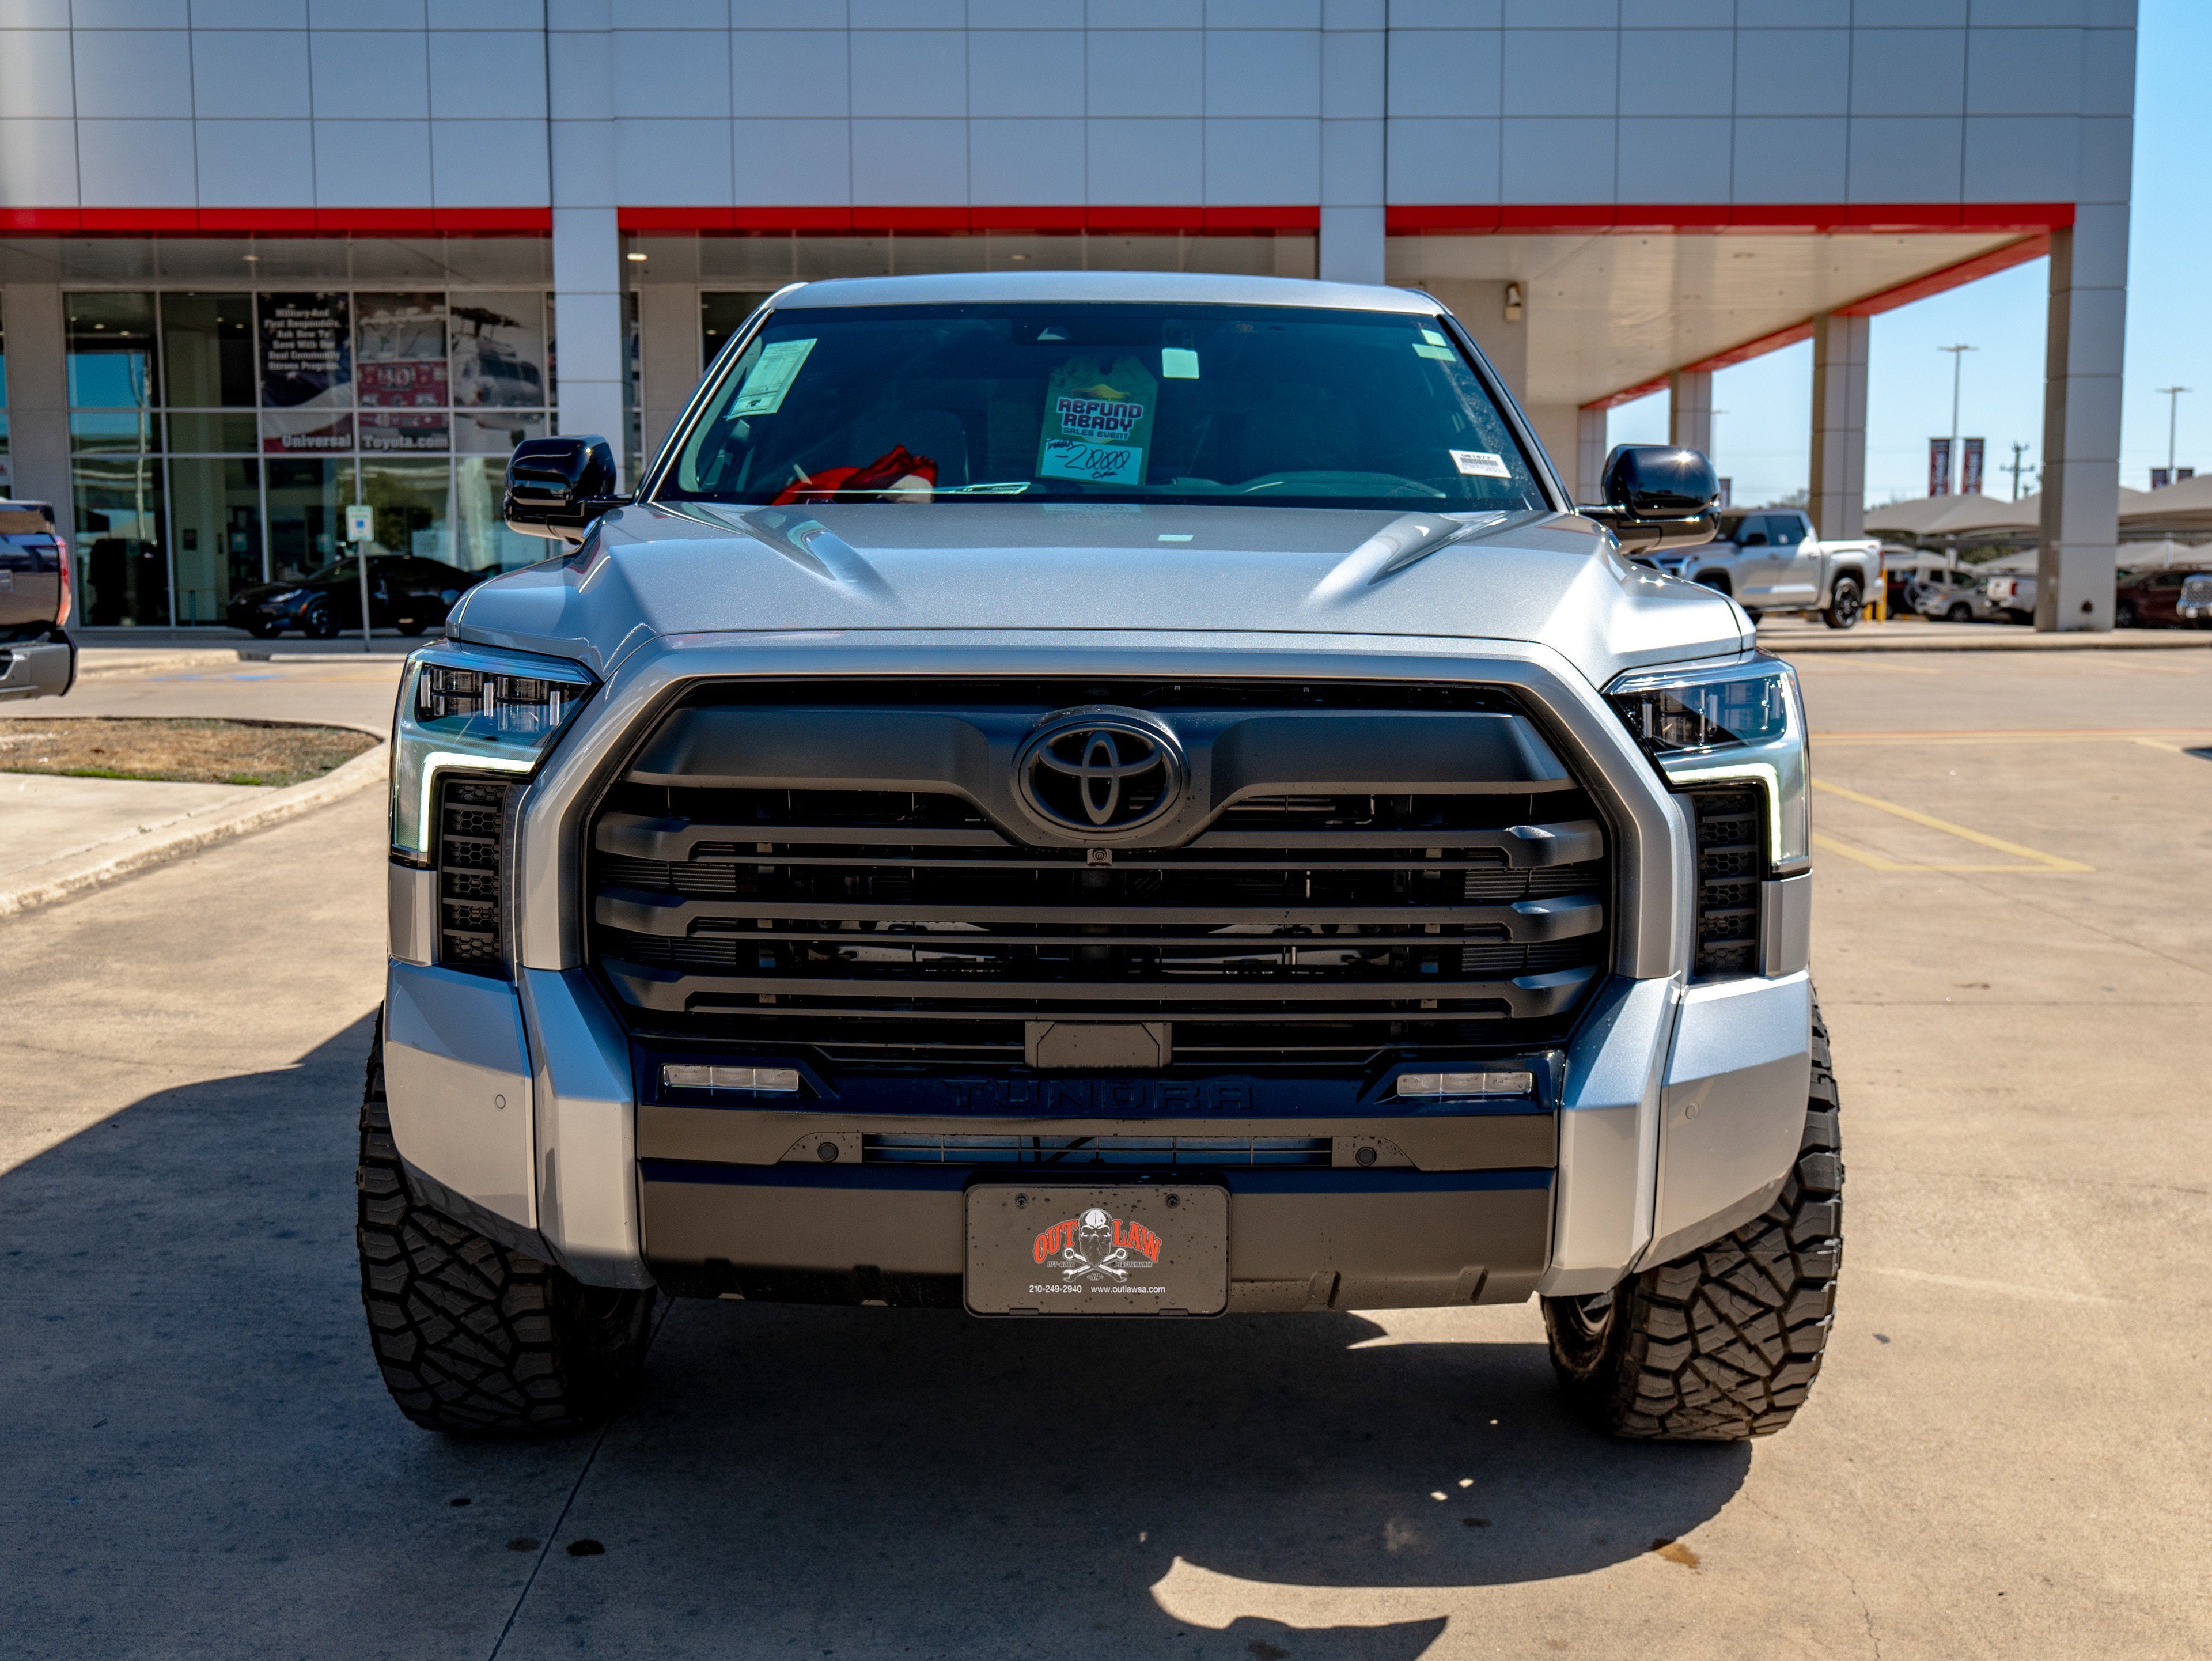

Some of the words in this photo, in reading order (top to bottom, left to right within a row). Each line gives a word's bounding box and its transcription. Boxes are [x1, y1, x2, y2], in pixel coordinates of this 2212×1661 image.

[1058, 398, 1142, 418] REFUND
[1063, 413, 1132, 432] READY
[282, 434, 352, 448] Universal
[363, 435, 448, 452] Toyota.com
[1063, 427, 1093, 437] SALES
[1097, 430, 1129, 441] EVENT
[941, 1079, 1253, 1110] TUNDRA
[1029, 1284, 1082, 1293] 210-249-2940
[1090, 1285, 1166, 1293] www.outlawsa.com
